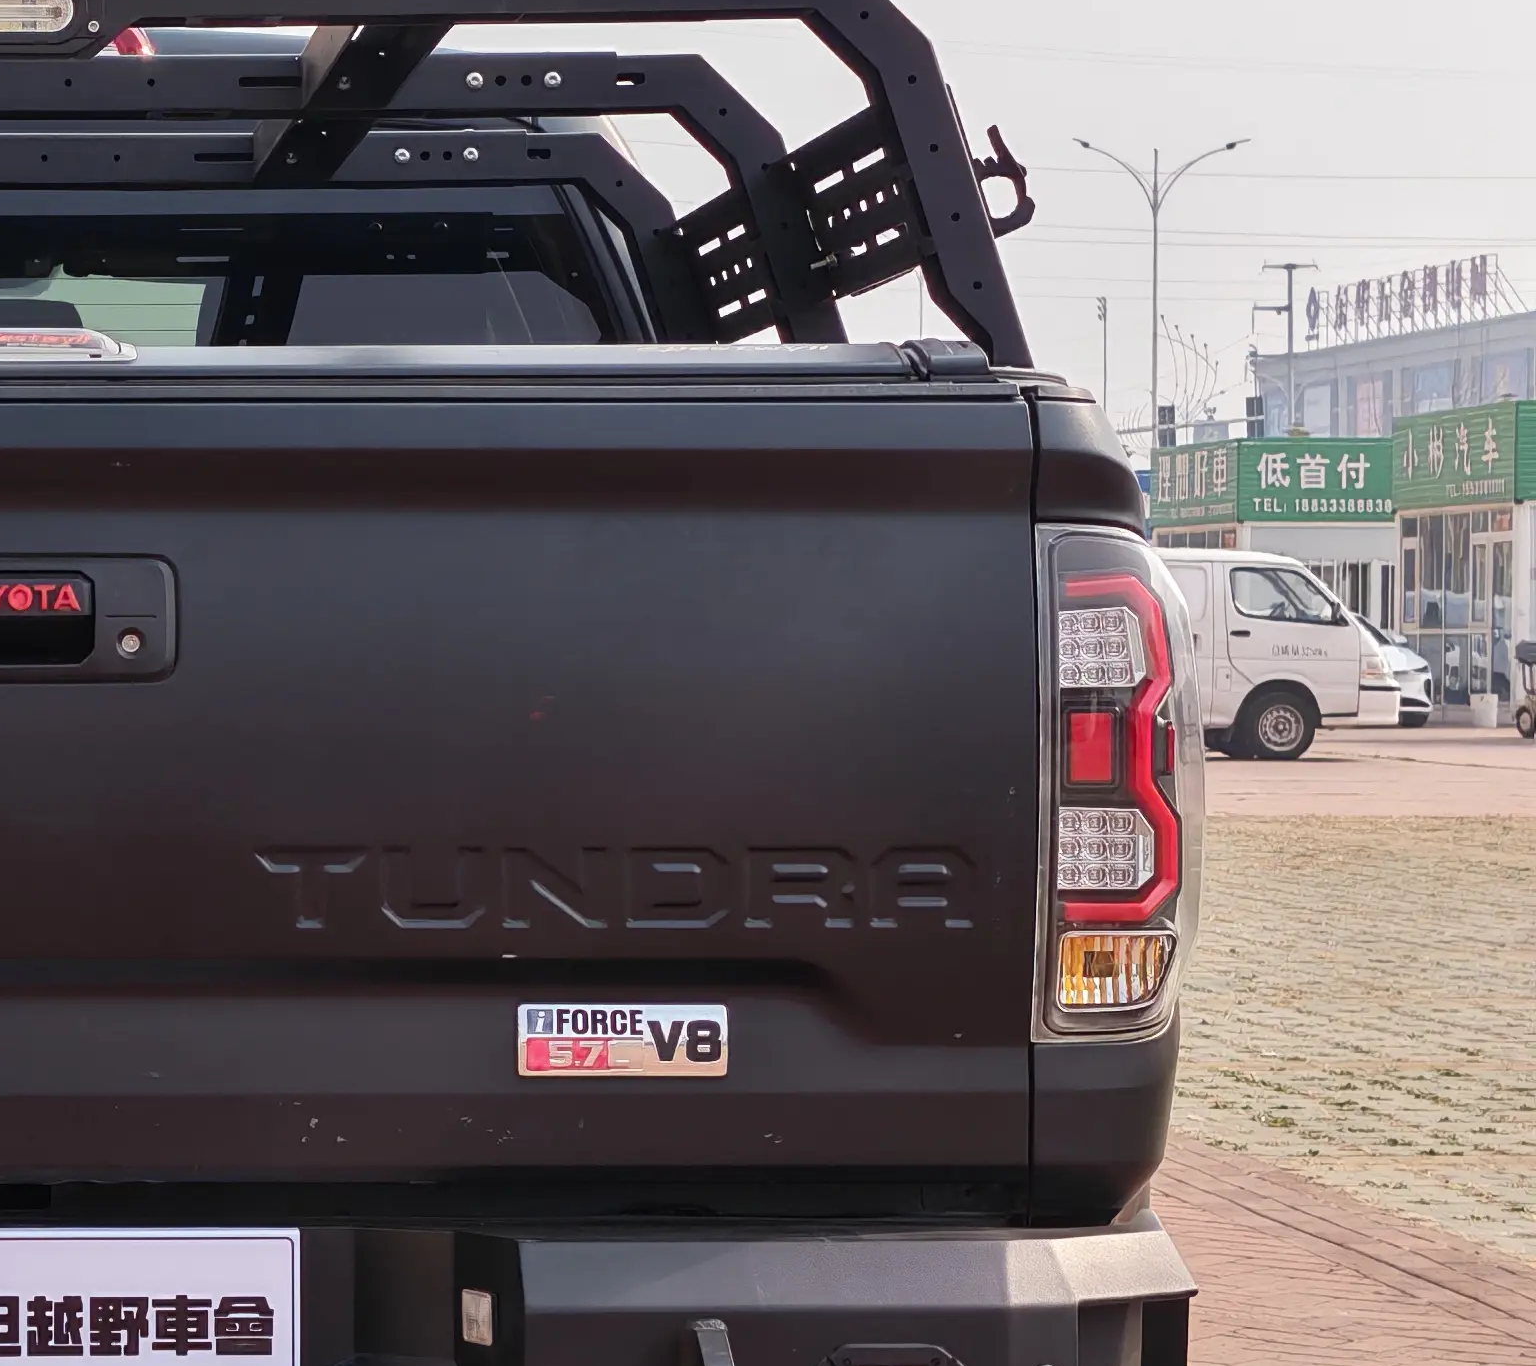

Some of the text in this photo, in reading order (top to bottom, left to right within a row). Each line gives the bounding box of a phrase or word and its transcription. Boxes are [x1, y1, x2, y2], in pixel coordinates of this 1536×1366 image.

[1256, 452, 1371, 490] 低首付
[254, 845, 977, 930] TUNDRA
[556, 1009, 644, 1036] FORCE
[646, 1019, 722, 1063] V8
